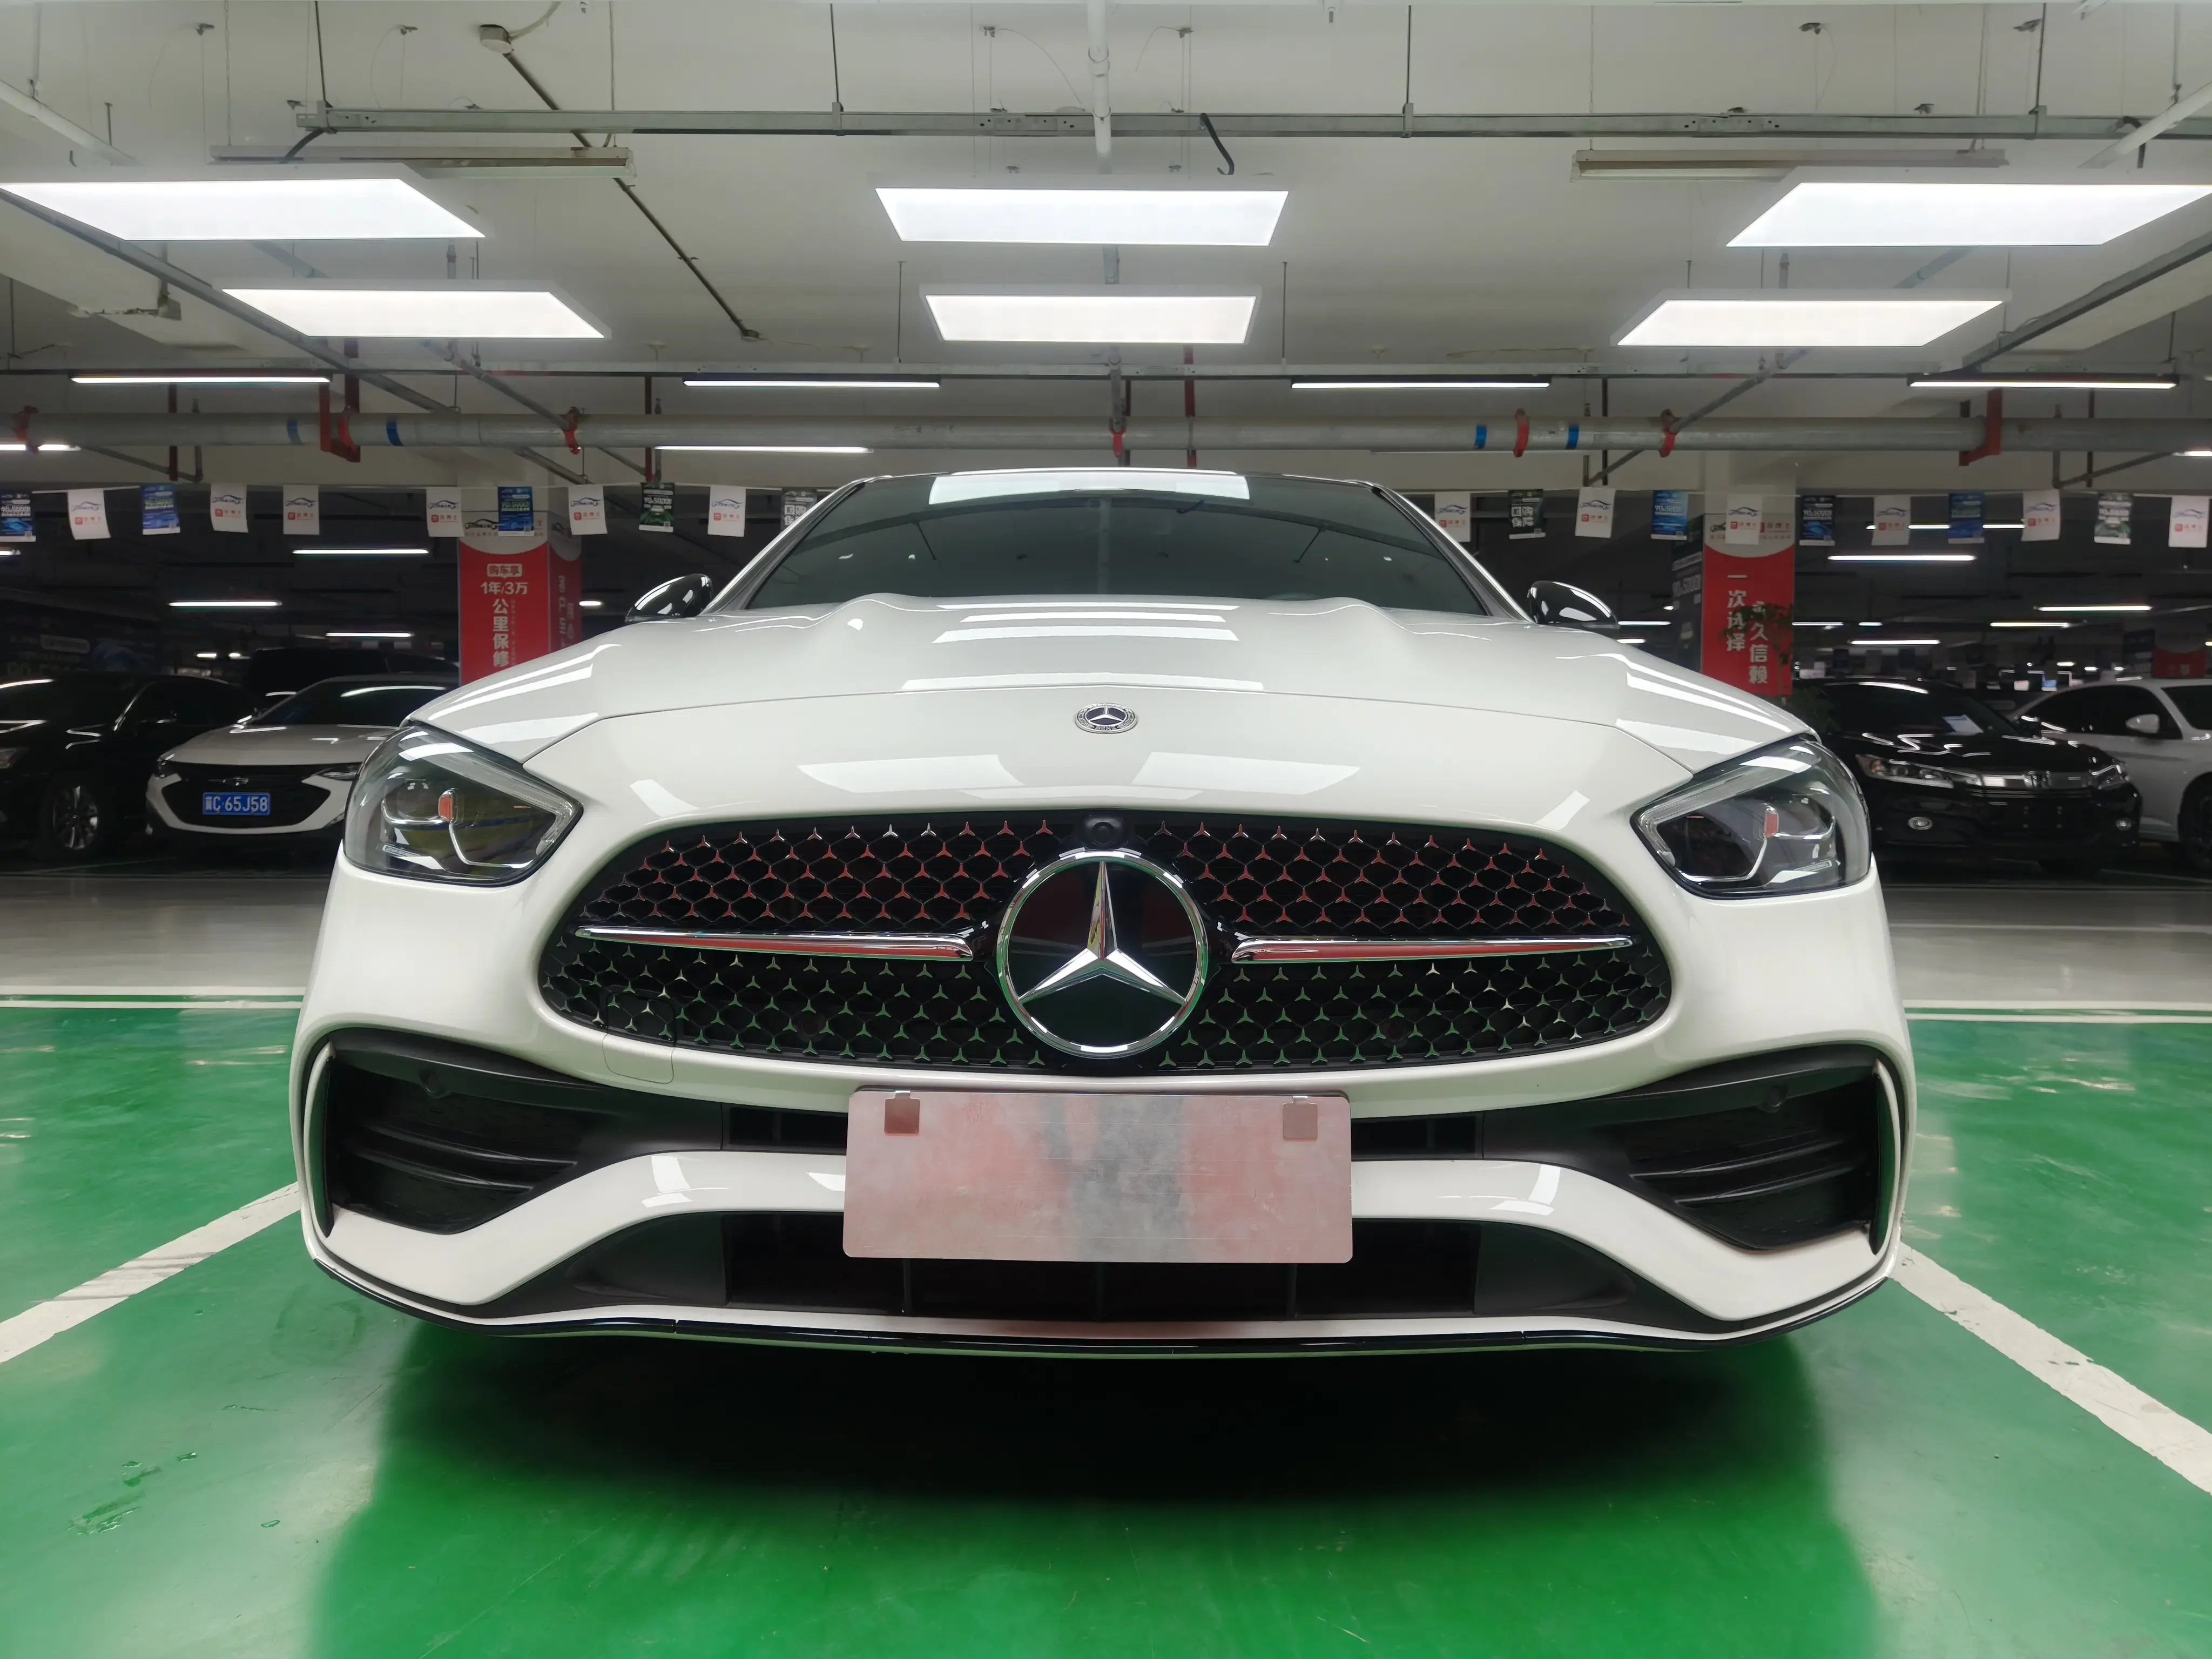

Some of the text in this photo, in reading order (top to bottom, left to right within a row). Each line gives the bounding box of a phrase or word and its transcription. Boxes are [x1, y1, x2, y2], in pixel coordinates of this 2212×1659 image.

[480, 582, 528, 595] 1年/3万
[492, 598, 509, 667] 公里保修
